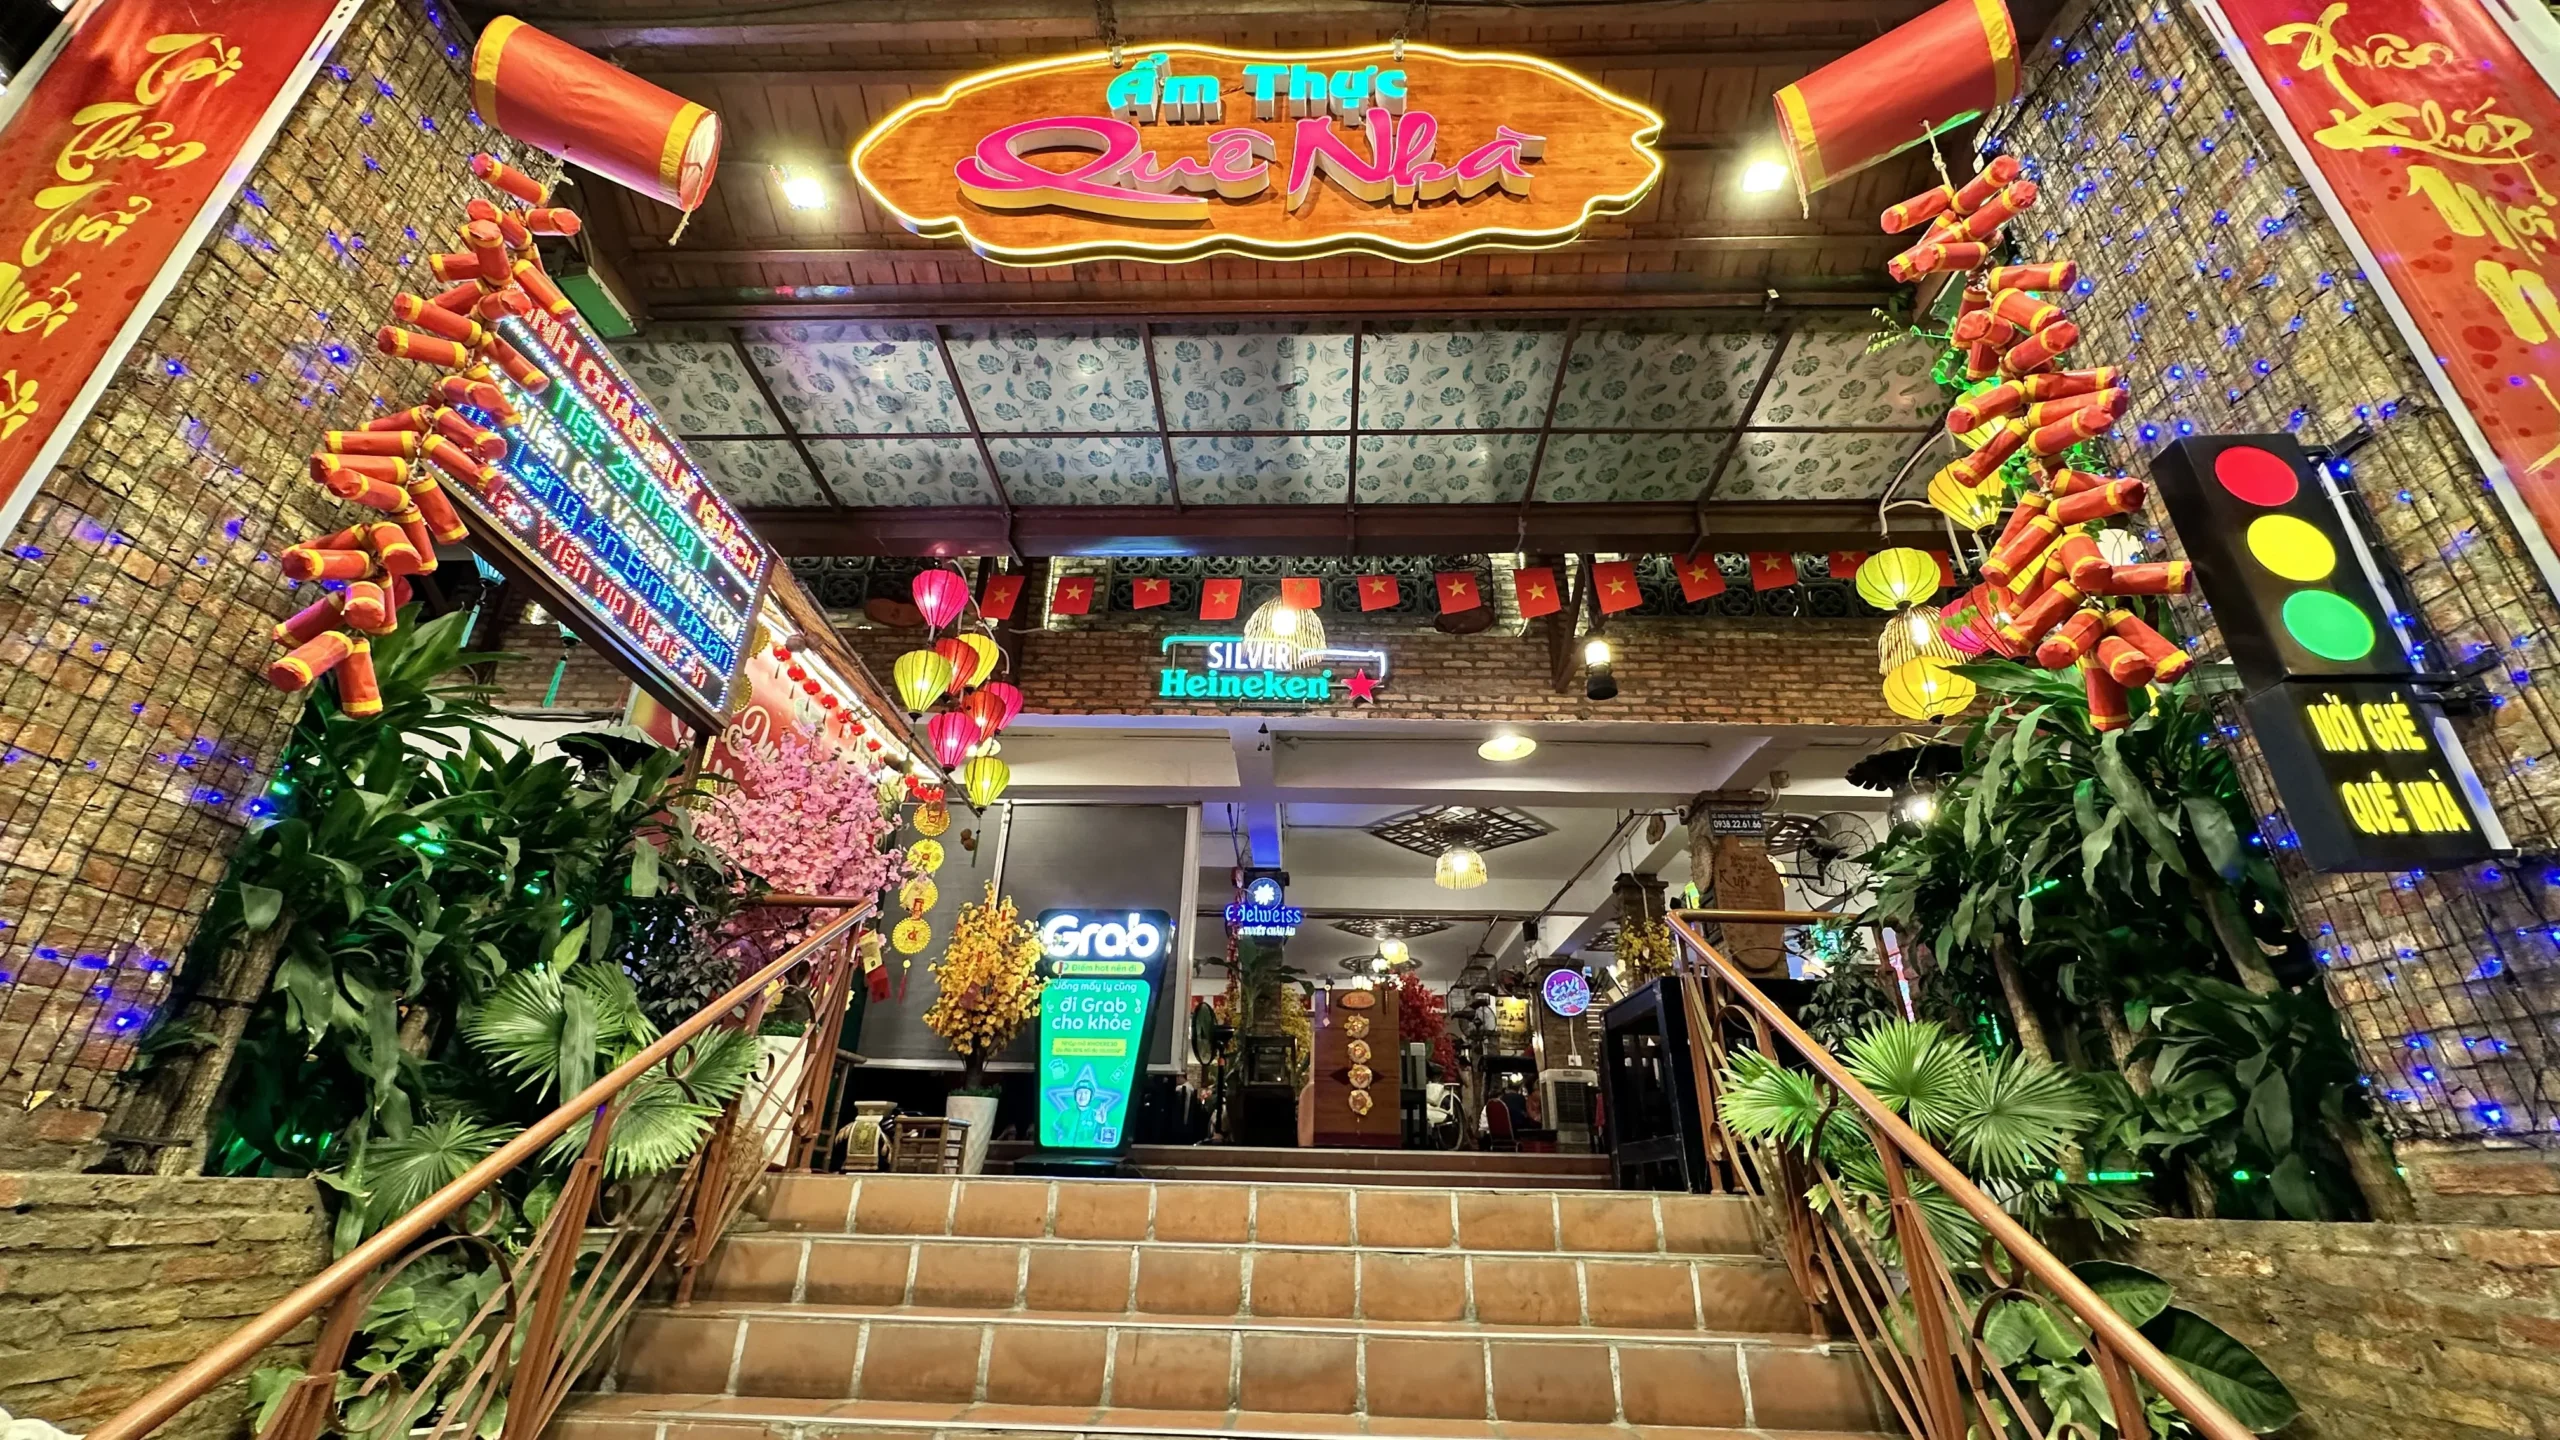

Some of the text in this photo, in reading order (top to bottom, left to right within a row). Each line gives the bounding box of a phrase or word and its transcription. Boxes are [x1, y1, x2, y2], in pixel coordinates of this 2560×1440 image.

[1243, 64, 1406, 124] Thực
[954, 107, 1545, 219] Quê Nhà
[572, 461, 611, 510] Cty
[606, 449, 638, 491] 25
[702, 549, 712, 571] 1
[1207, 641, 1291, 670] SILVER
[1159, 669, 1331, 700] Heineken
[2307, 691, 2427, 753] MỜI GHÉ
[2341, 769, 2471, 834] QUÊ NHÀ
[1043, 913, 1160, 958] Grab
[1225, 904, 1302, 924] Edelweiss
[1094, 963, 1109, 972] hot
[1052, 1013, 1132, 1030] cho khỏe
[1060, 997, 1127, 1013] đi Grab
